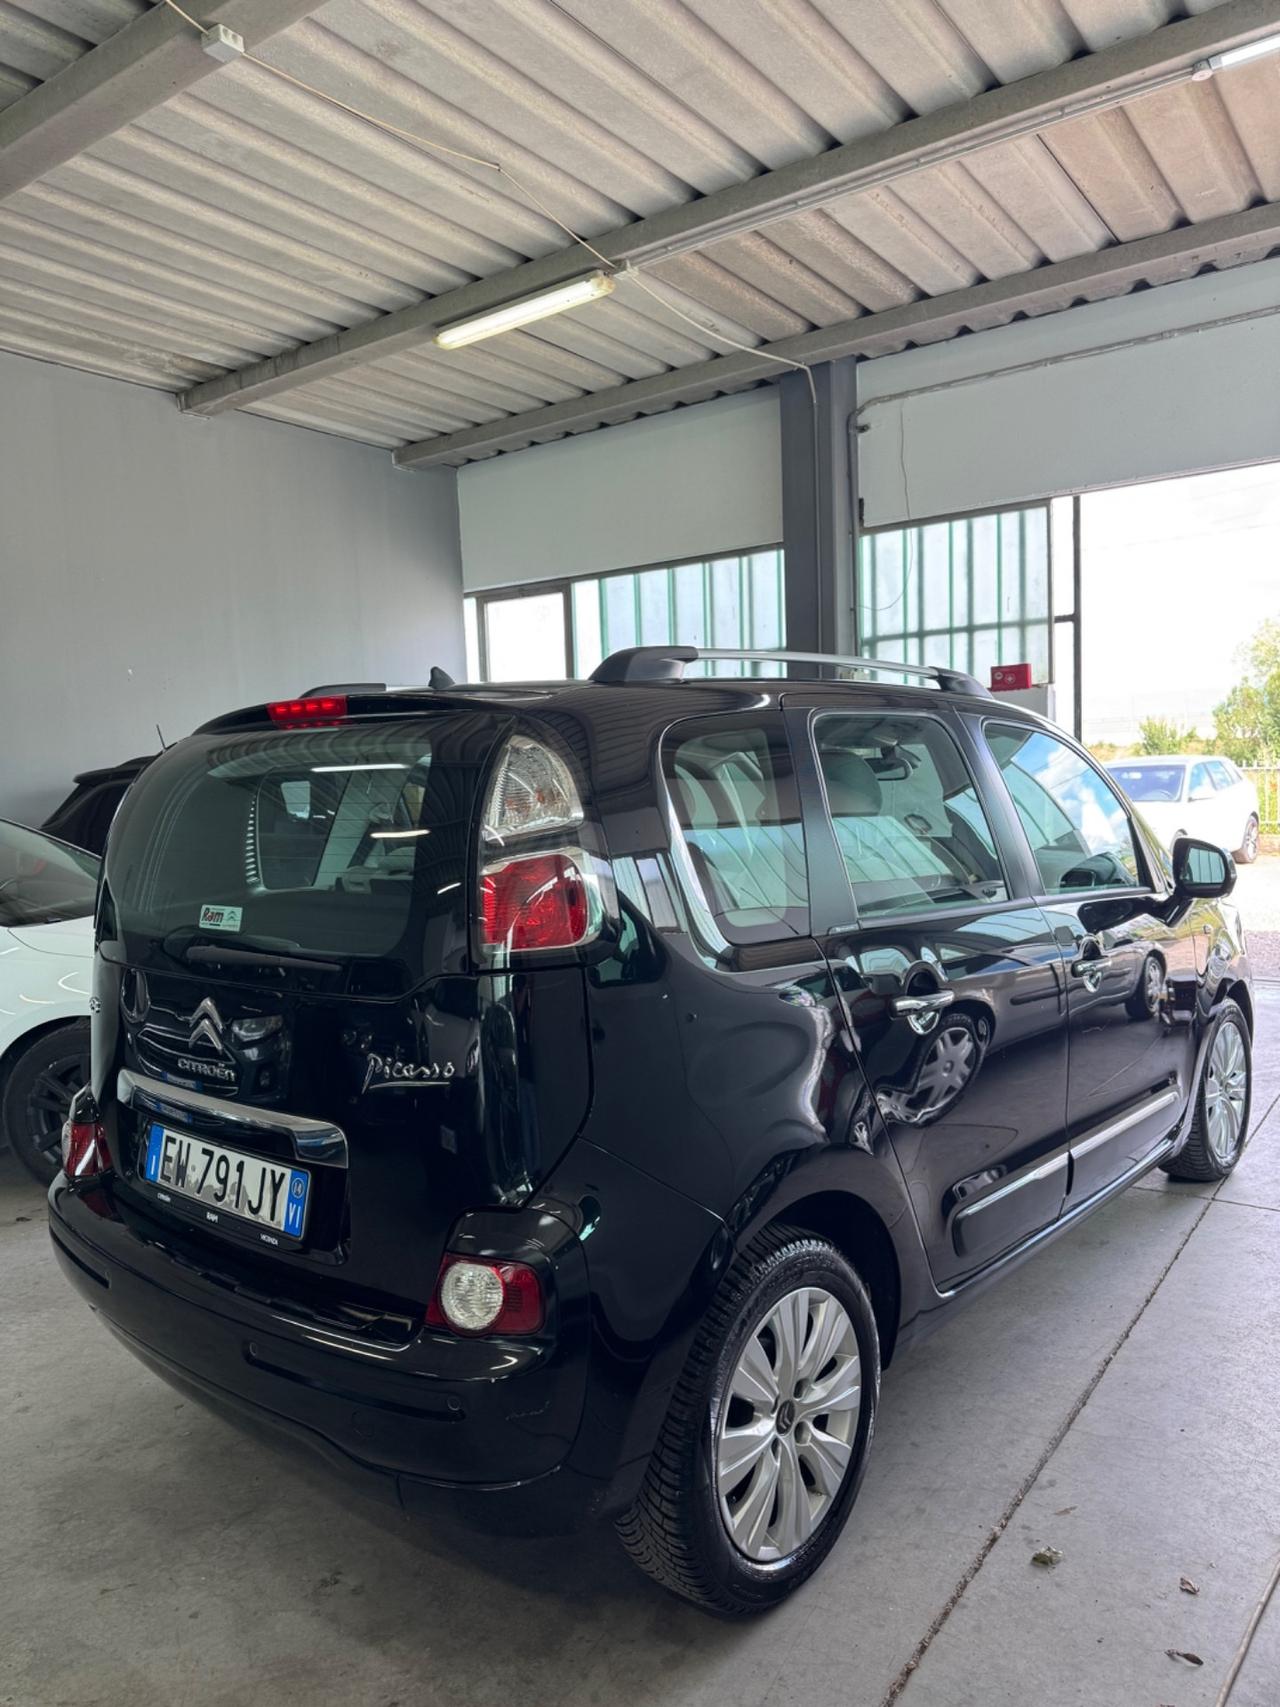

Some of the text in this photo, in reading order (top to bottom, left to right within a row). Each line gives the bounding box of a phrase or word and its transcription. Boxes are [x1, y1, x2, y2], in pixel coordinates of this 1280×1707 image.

[201, 907, 224, 923] Ram
[362, 1053, 455, 1094] Picasso
[159, 1135, 191, 1188] EW
[288, 1202, 301, 1229] VI
